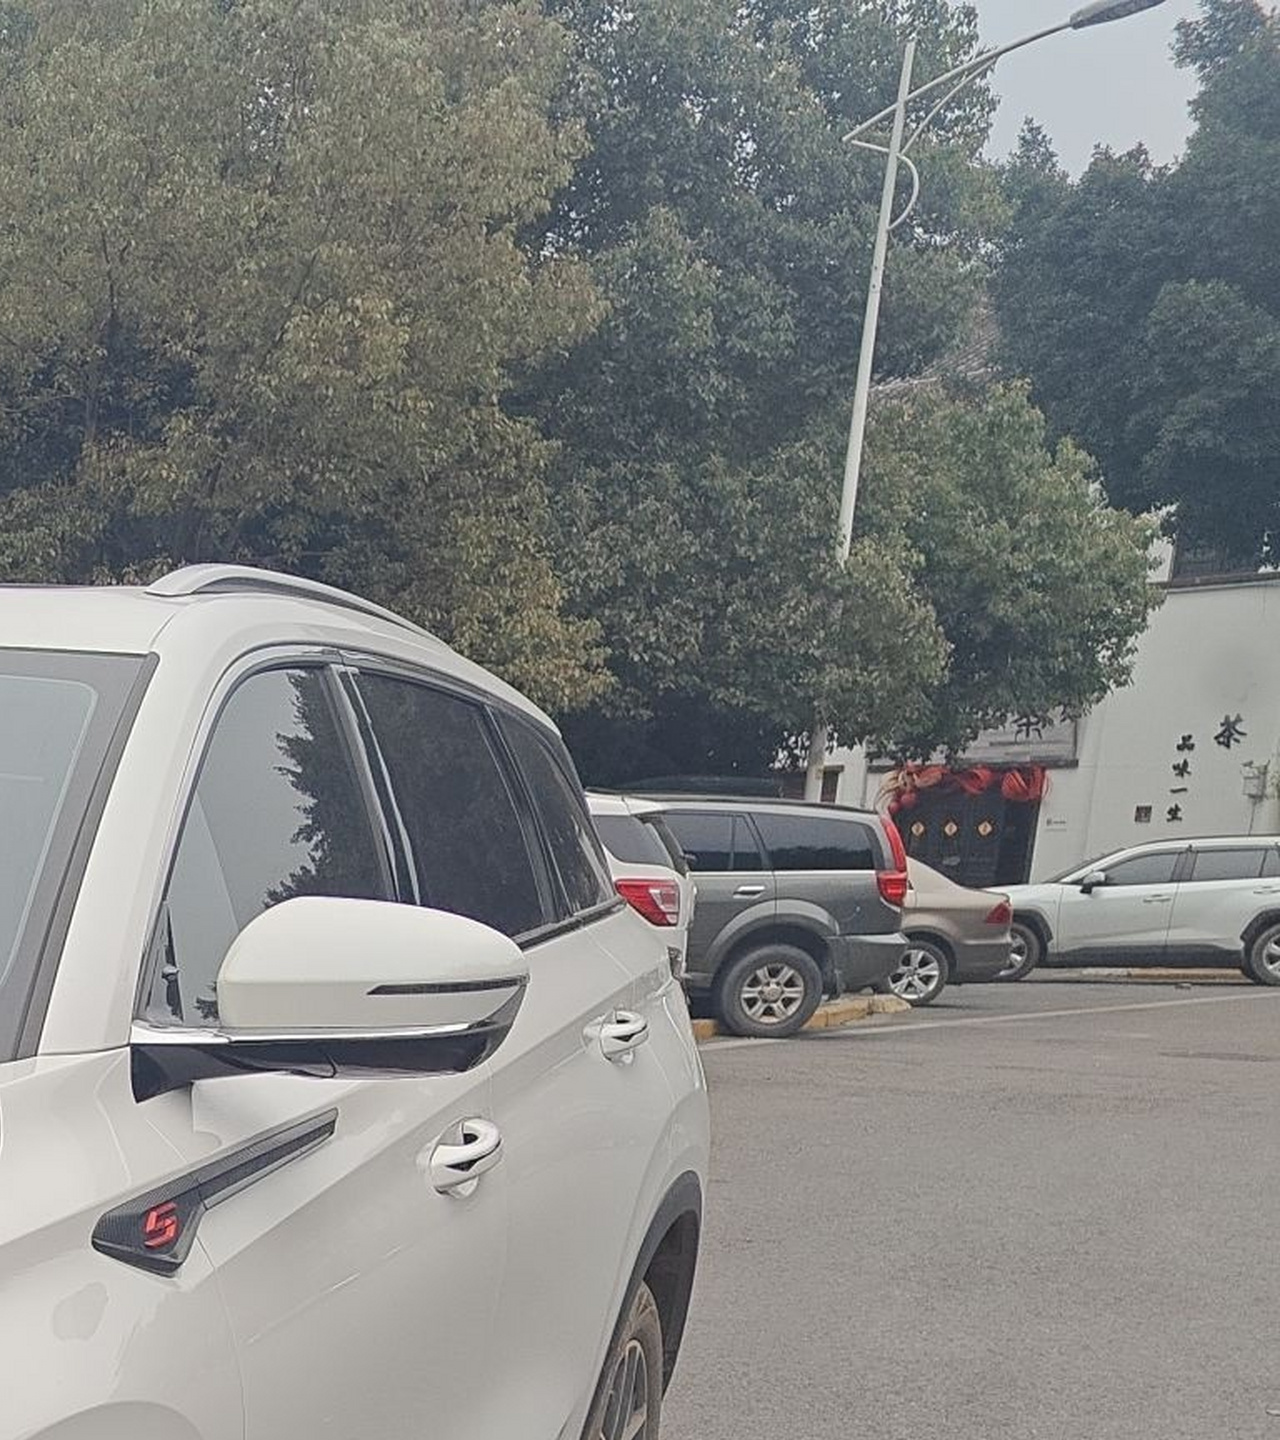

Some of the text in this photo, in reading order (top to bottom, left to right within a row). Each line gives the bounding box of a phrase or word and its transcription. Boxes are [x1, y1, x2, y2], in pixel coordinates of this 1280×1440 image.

[1213, 713, 1247, 749] 茶
[1165, 734, 1195, 822] 品味一生
